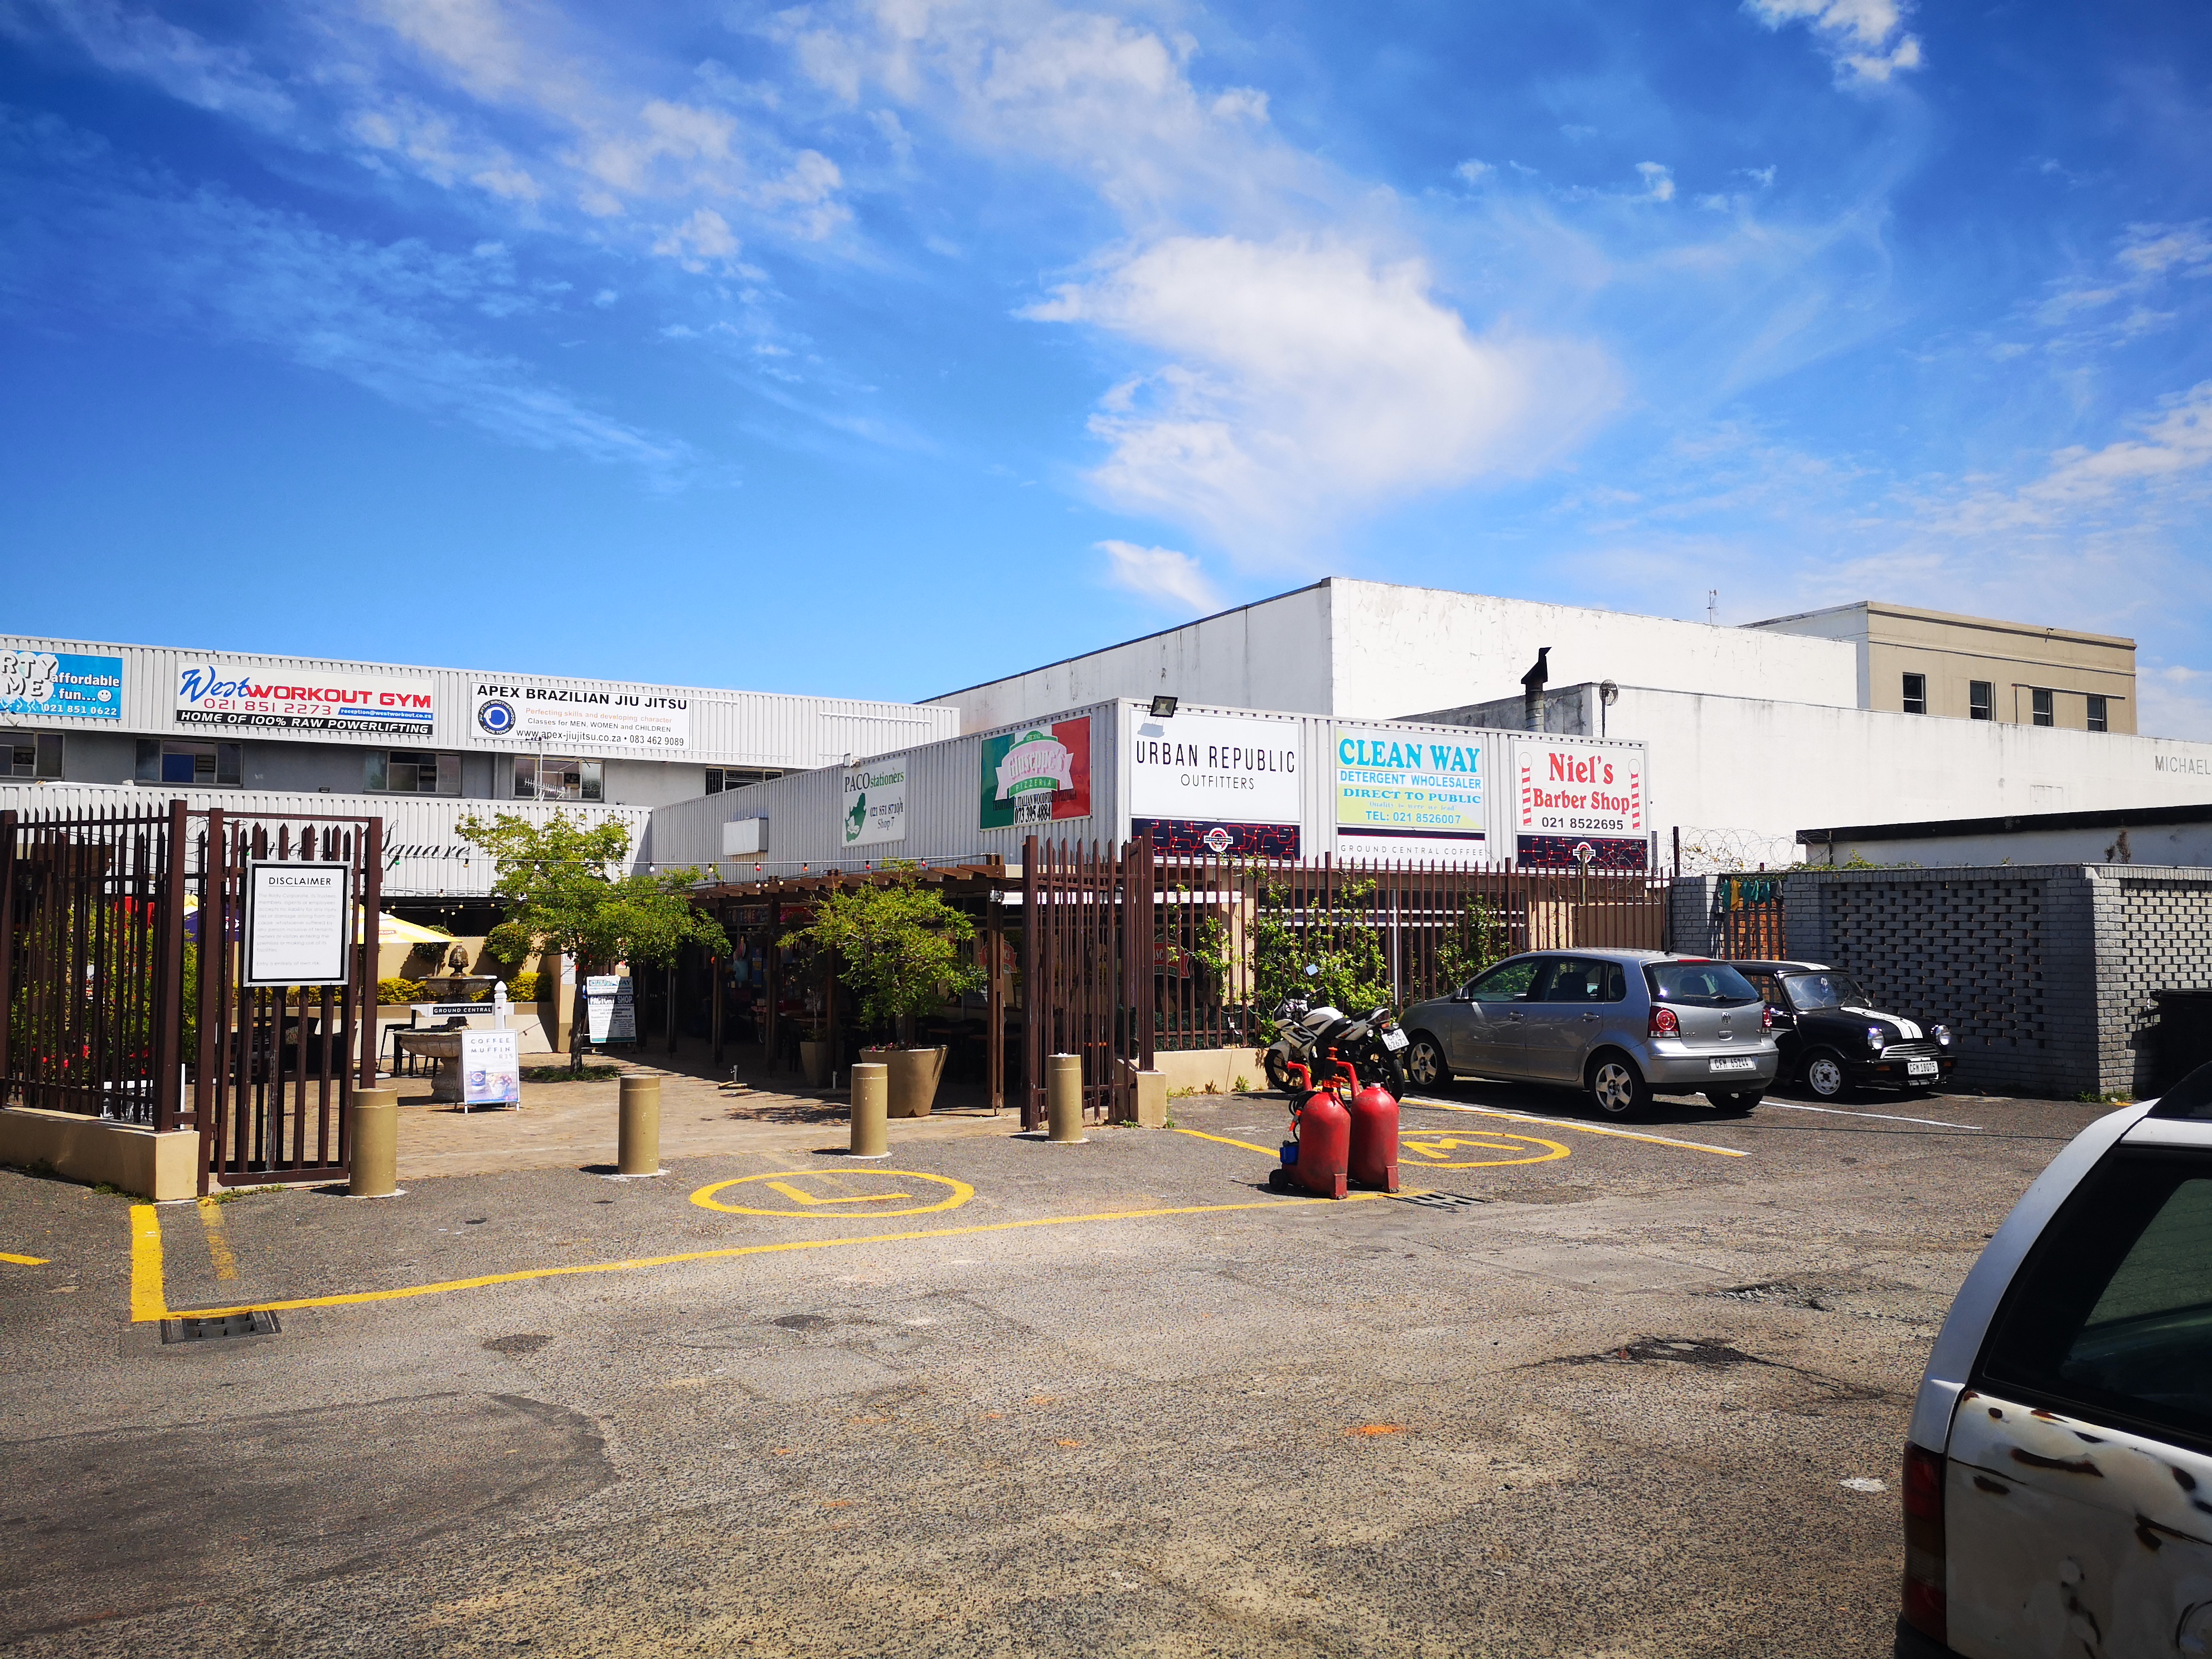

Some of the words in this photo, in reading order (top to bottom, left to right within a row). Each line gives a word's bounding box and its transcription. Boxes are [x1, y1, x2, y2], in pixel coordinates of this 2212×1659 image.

[51, 672, 120, 687] affordable
[59, 688, 96, 701] fun...
[380, 692, 431, 709] GYM
[477, 685, 521, 698] APEX
[526, 688, 609, 705] BRAZILIAN
[614, 695, 639, 706] JIU
[644, 697, 687, 710] JITSU
[43, 704, 64, 712] 021
[67, 706, 86, 714] 851
[90, 706, 117, 715] 0622
[204, 698, 235, 710] 021
[245, 701, 275, 712] 851
[284, 703, 331, 715] 2273
[341, 709, 431, 719] reception@westworkout.co.za
[526, 708, 562, 717] Perfecting
[600, 713, 638, 722] developing
[181, 712, 222, 722] HOME
[227, 715, 247, 724] OF
[251, 716, 287, 726] 100%
[291, 718, 324, 727] RAW
[327, 720, 429, 734] POWERLIFTING
[630, 735, 644, 744] 083
[647, 736, 662, 745] 462
[664, 737, 684, 746] 9089
[1137, 741, 1197, 767] URBAN
[1209, 745, 1294, 773] REPUBLIC
[1339, 738, 1422, 769] CLEAN
[1429, 745, 1480, 773] WAY
[1549, 753, 1614, 784] Niel's
[2155, 755, 2211, 775] MICHAEL
[1015, 779, 1051, 792] PIZZERIA
[1181, 774, 1254, 790] OUTFITTERS
[1340, 770, 1406, 784] DETERGENT
[1411, 775, 1481, 789] WHOLESALER
[1343, 788, 1400, 799] DIRECT
[1405, 792, 1424, 801] TO
[1428, 793, 1481, 804] PUBLIC
[1533, 788, 1587, 808] Barber
[1590, 791, 1629, 814] Shop
[1015, 807, 1024, 824] 073
[1366, 811, 1389, 821] TEL:
[1393, 812, 1411, 822] 021
[1416, 813, 1461, 824] 8526007
[877, 819, 891, 831] Shop
[891, 817, 895, 827] 7
[1541, 817, 1564, 828] 021
[1570, 818, 1623, 830] 8522695
[1341, 845, 1387, 853] GROUND
[1392, 846, 1439, 855] CENTRAL
[1444, 847, 1483, 856] COFFEE
[269, 877, 331, 885] DISCLAIMER
[617, 995, 633, 1003] SHOP
[1714, 1058, 1728, 1069] CFM
[1909, 1064, 1920, 1073] CFM
